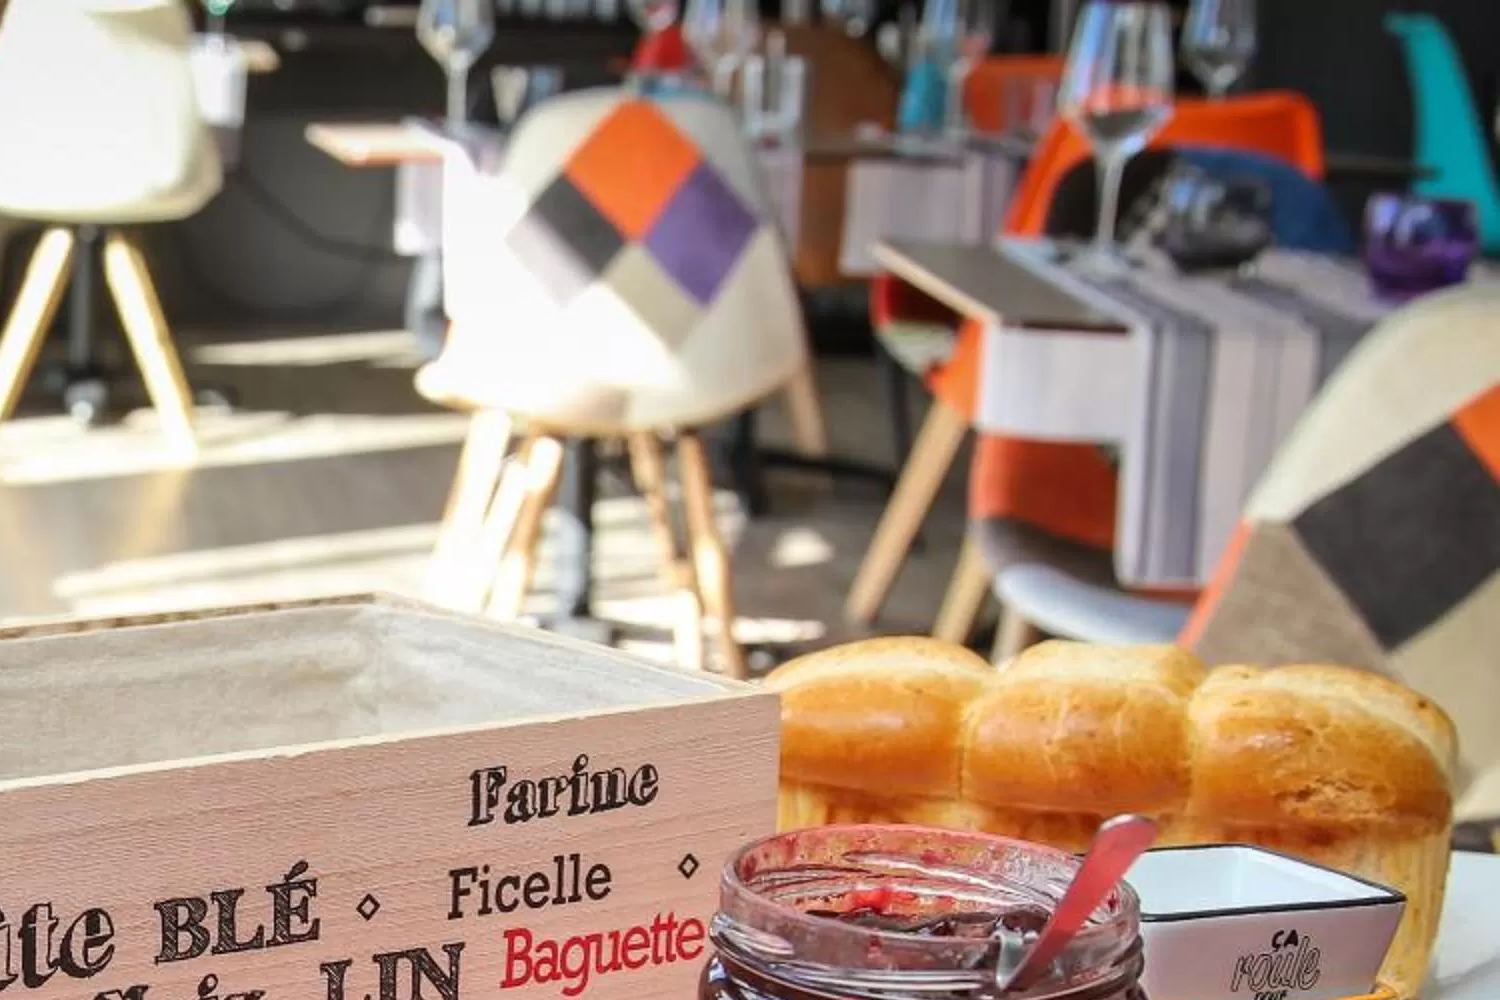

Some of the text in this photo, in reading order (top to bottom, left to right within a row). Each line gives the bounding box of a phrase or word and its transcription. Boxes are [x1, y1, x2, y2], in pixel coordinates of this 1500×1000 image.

[467, 753, 660, 827] Farine
[154, 860, 321, 966] BLÉ
[447, 853, 613, 920] Ficelle
[500, 911, 706, 997] Baguette
[1230, 935, 1321, 993] roule
